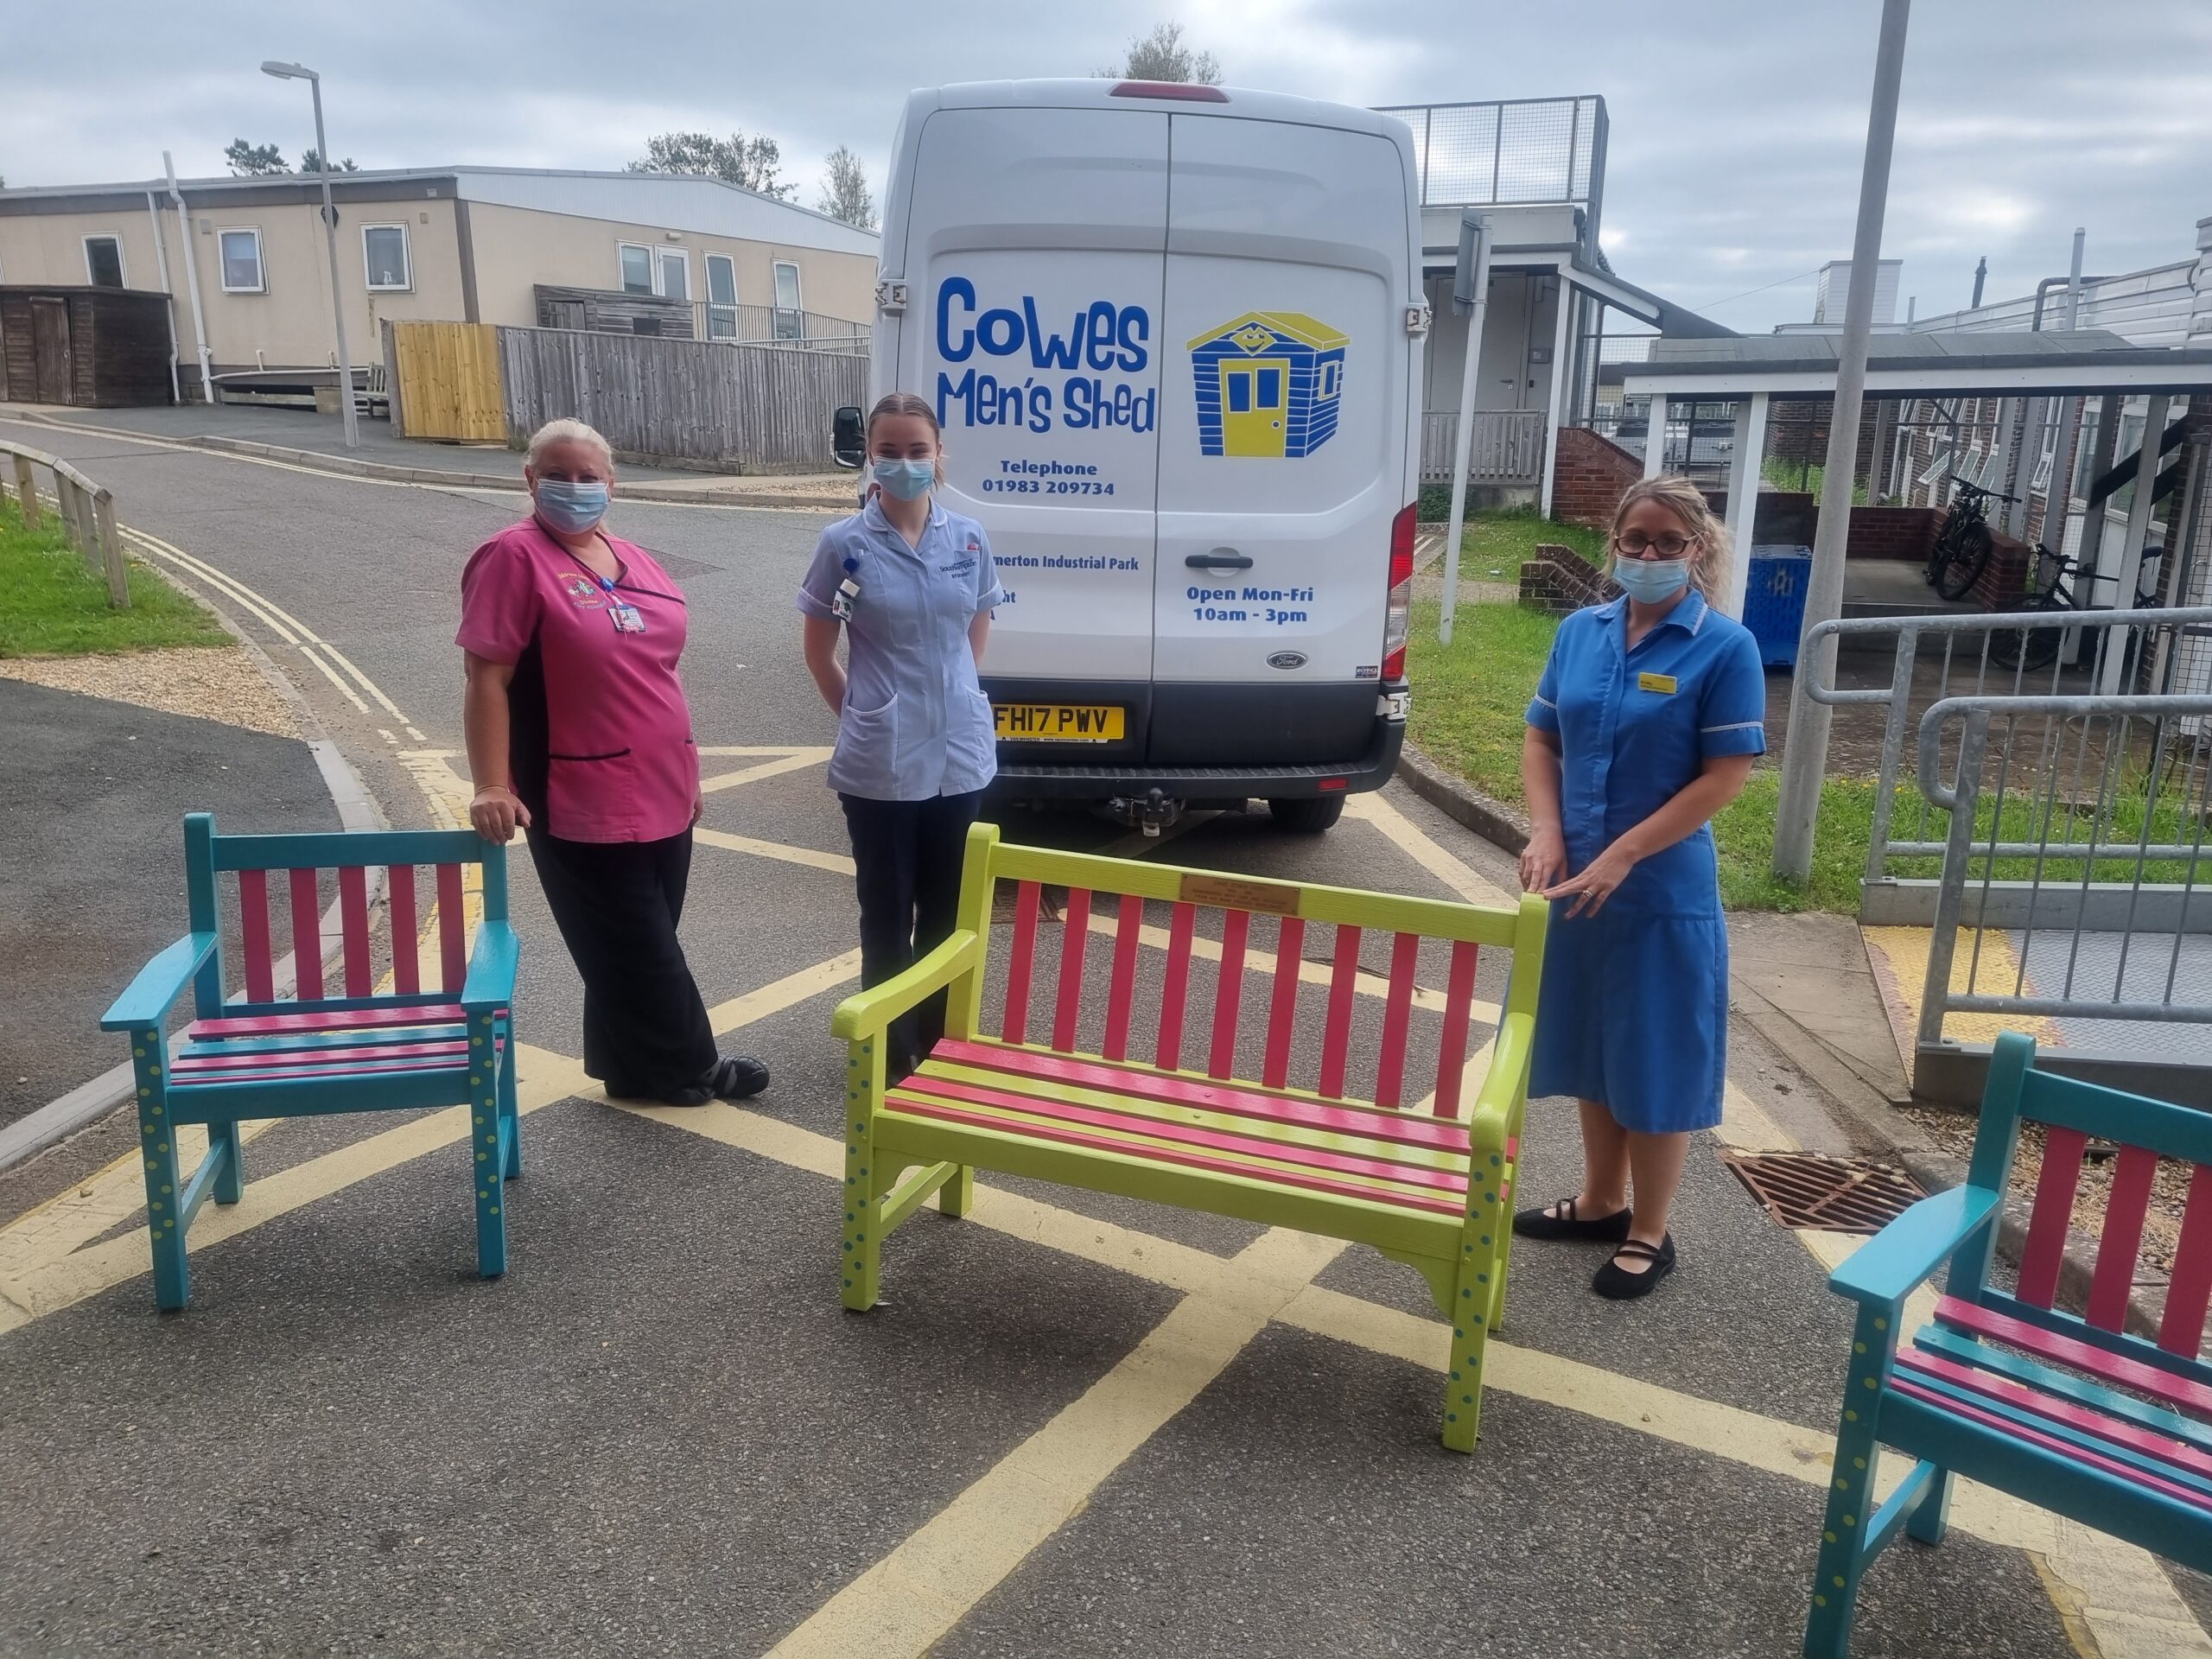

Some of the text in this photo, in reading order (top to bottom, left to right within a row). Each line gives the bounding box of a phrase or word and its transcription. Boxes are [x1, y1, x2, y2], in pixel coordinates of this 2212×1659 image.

[938, 369, 1155, 433] Men's Shed
[1001, 460, 1097, 477] Telephone
[982, 480, 1115, 495] 01983 209734
[939, 561, 977, 572] Southampton
[994, 555, 1139, 570] merton Industrial Park
[1187, 587, 1313, 603] Open Mon-Fri
[1193, 607, 1246, 621] 10am
[1265, 608, 1307, 625] 3pm
[1276, 653, 1299, 665] Ford
[994, 707, 1108, 733] FH17 PWV
